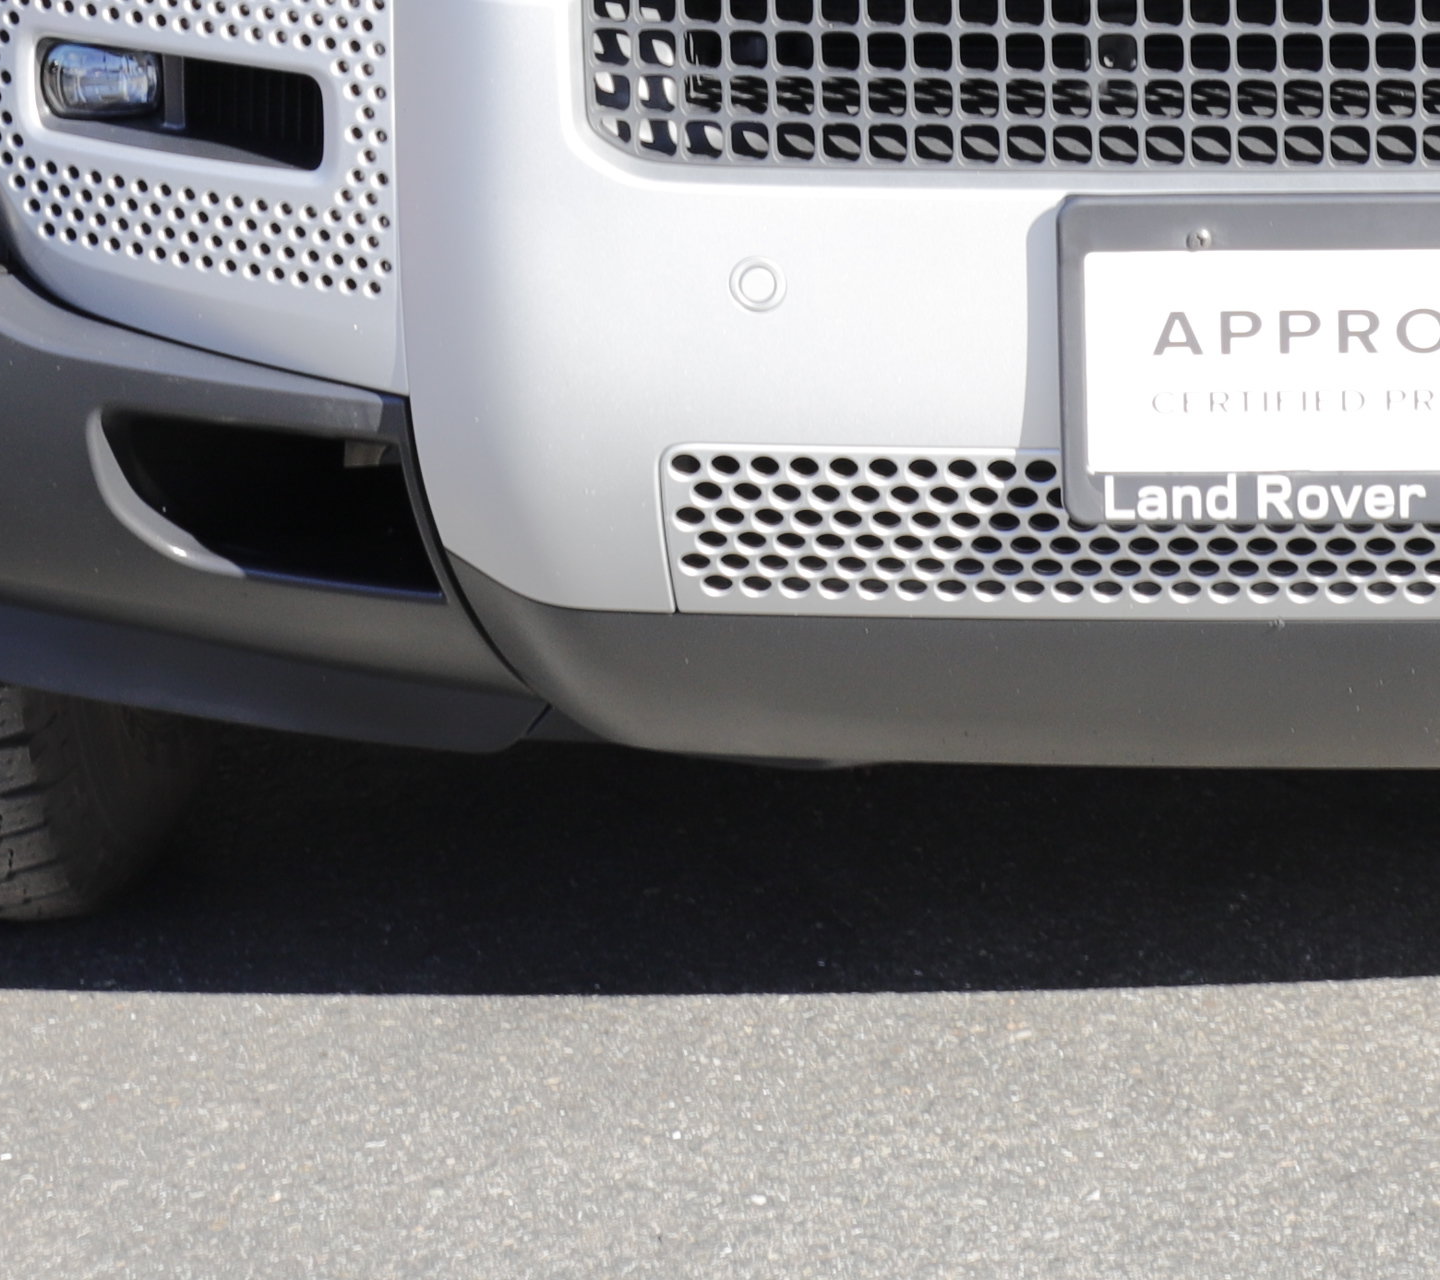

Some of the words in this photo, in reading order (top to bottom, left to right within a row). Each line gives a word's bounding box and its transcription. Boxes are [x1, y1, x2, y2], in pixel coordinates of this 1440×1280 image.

[1151, 388, 1366, 415] CERTIFIED
[1104, 472, 1238, 521] Land
[1257, 473, 1427, 520] Rover
